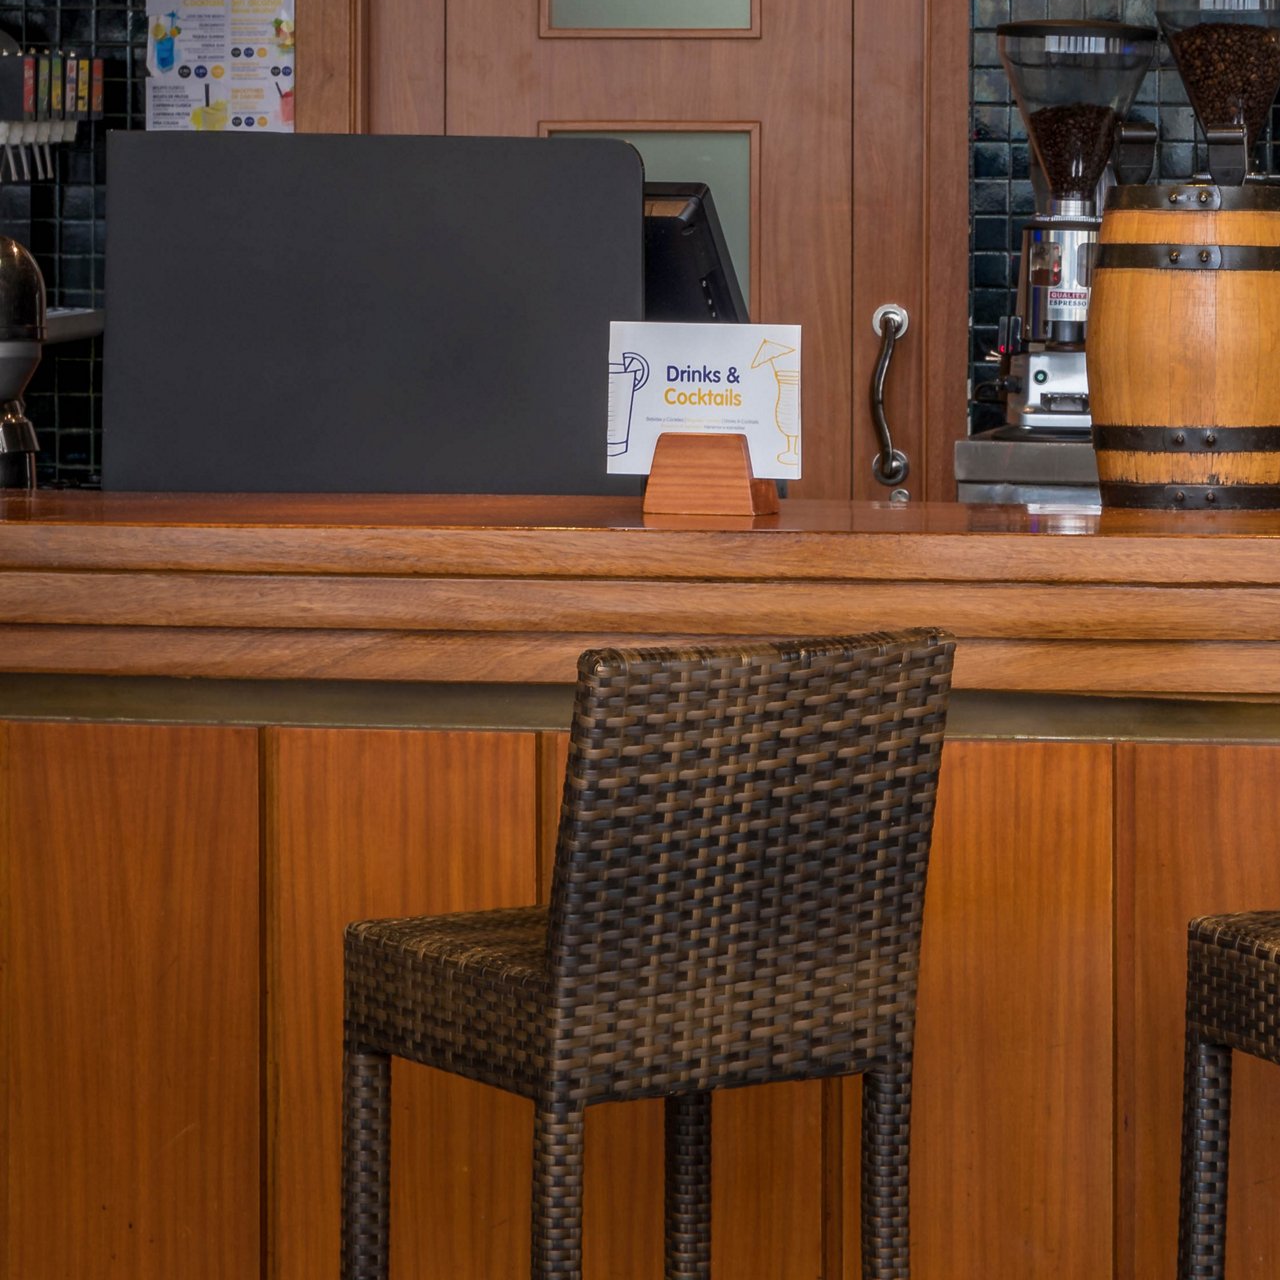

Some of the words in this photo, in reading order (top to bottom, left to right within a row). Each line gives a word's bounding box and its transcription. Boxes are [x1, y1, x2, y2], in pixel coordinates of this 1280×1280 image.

[666, 365, 721, 383] Drinks
[727, 367, 740, 384] &
[664, 387, 742, 406] Cocktails
